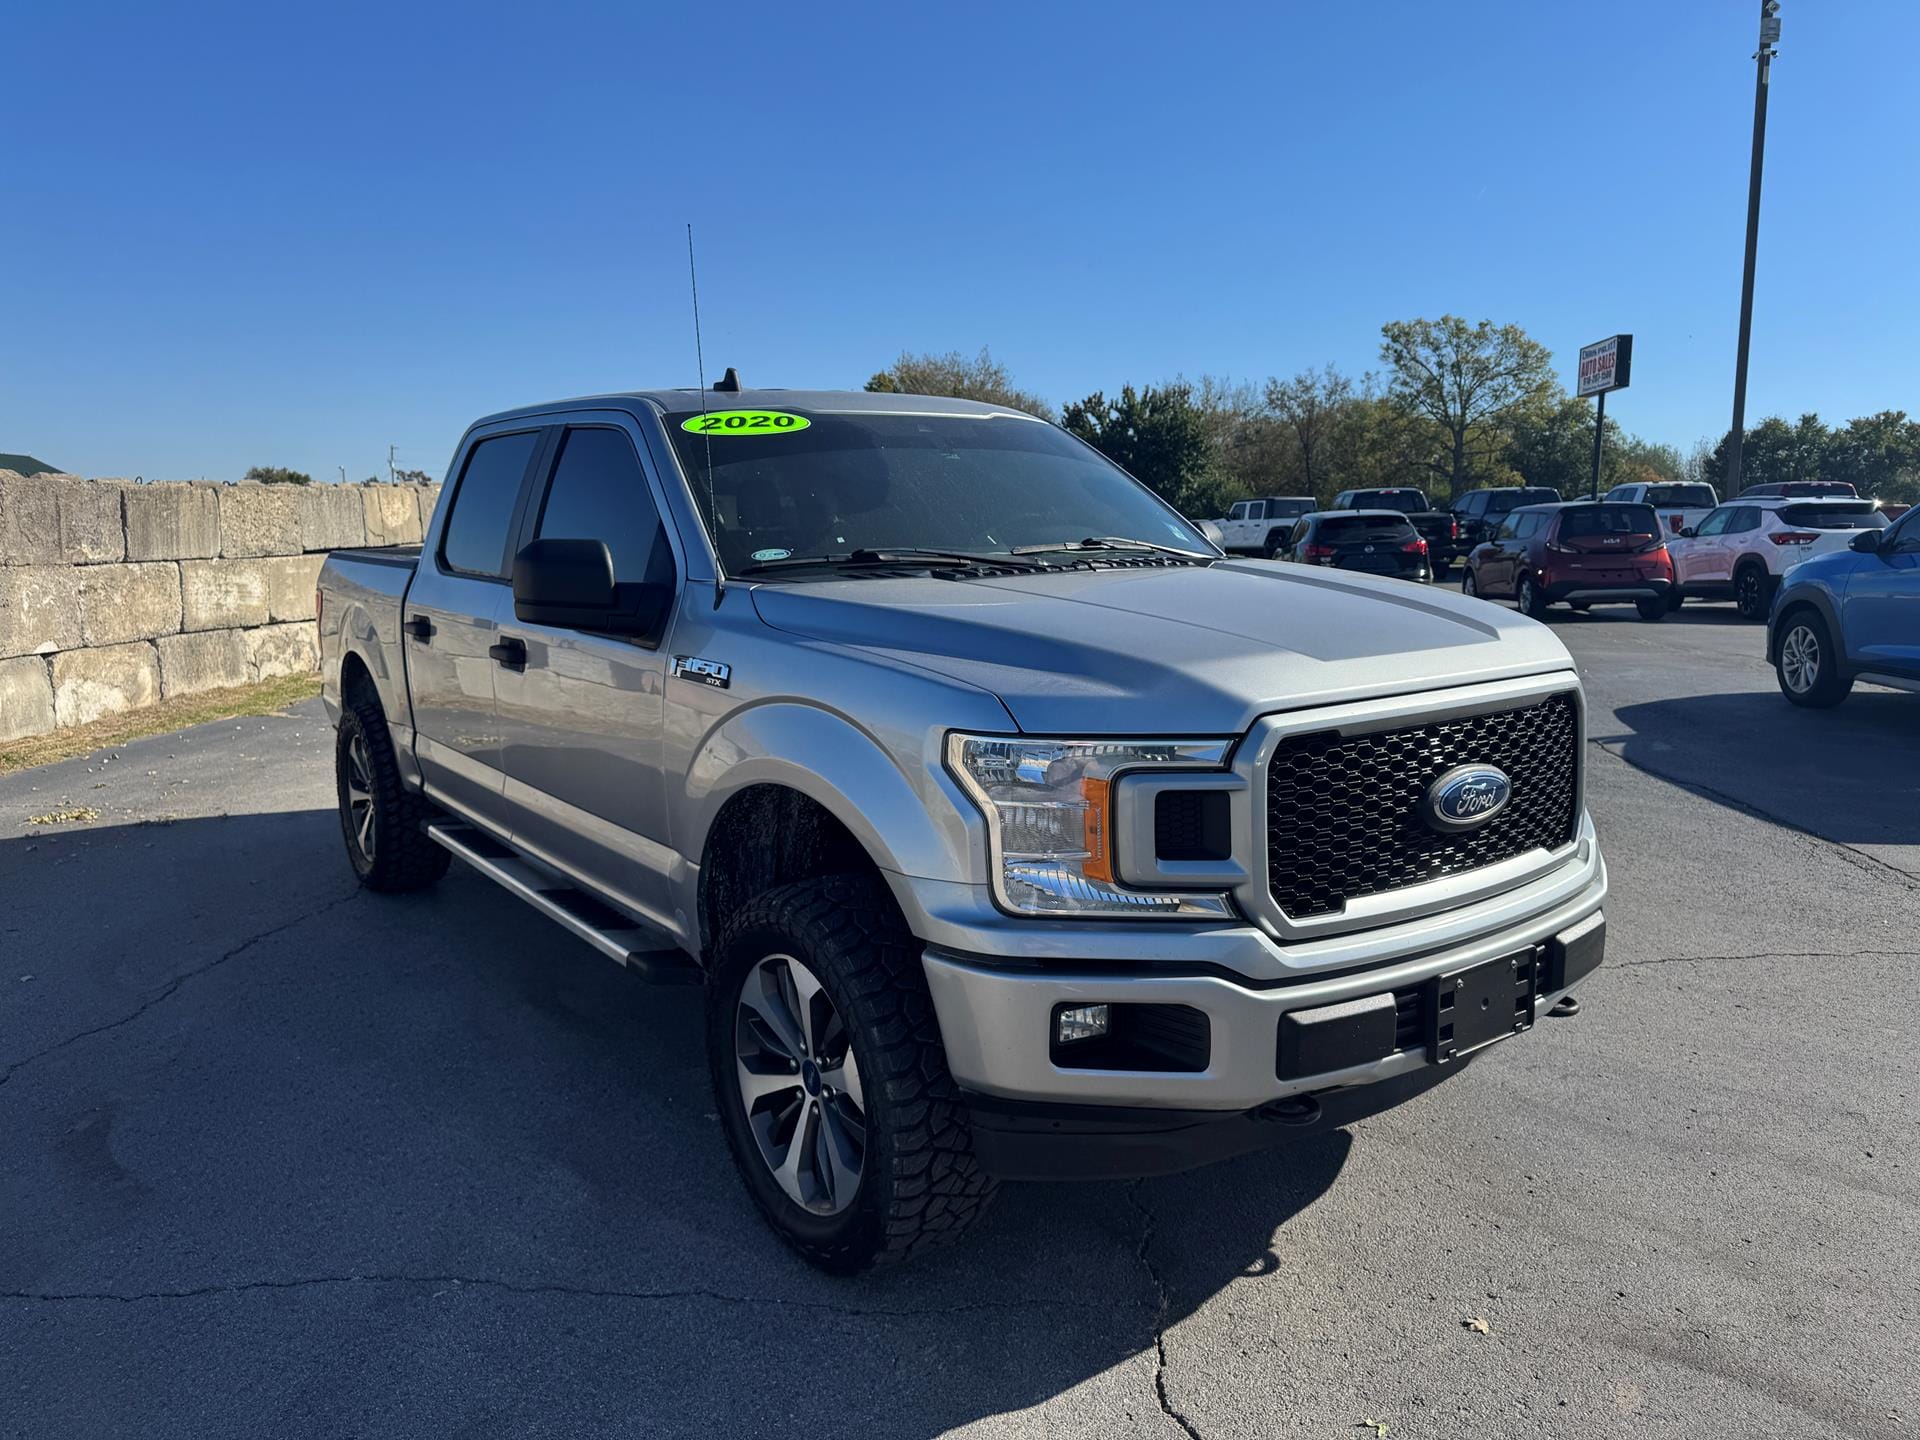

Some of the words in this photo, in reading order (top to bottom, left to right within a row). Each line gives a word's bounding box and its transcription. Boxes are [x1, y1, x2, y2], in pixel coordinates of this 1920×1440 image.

[1581, 357, 1597, 377] AUTO
[1598, 351, 1616, 372] SALES
[699, 415, 795, 431] 2020
[706, 678, 721, 687] STX
[1456, 782, 1497, 815] Ford
